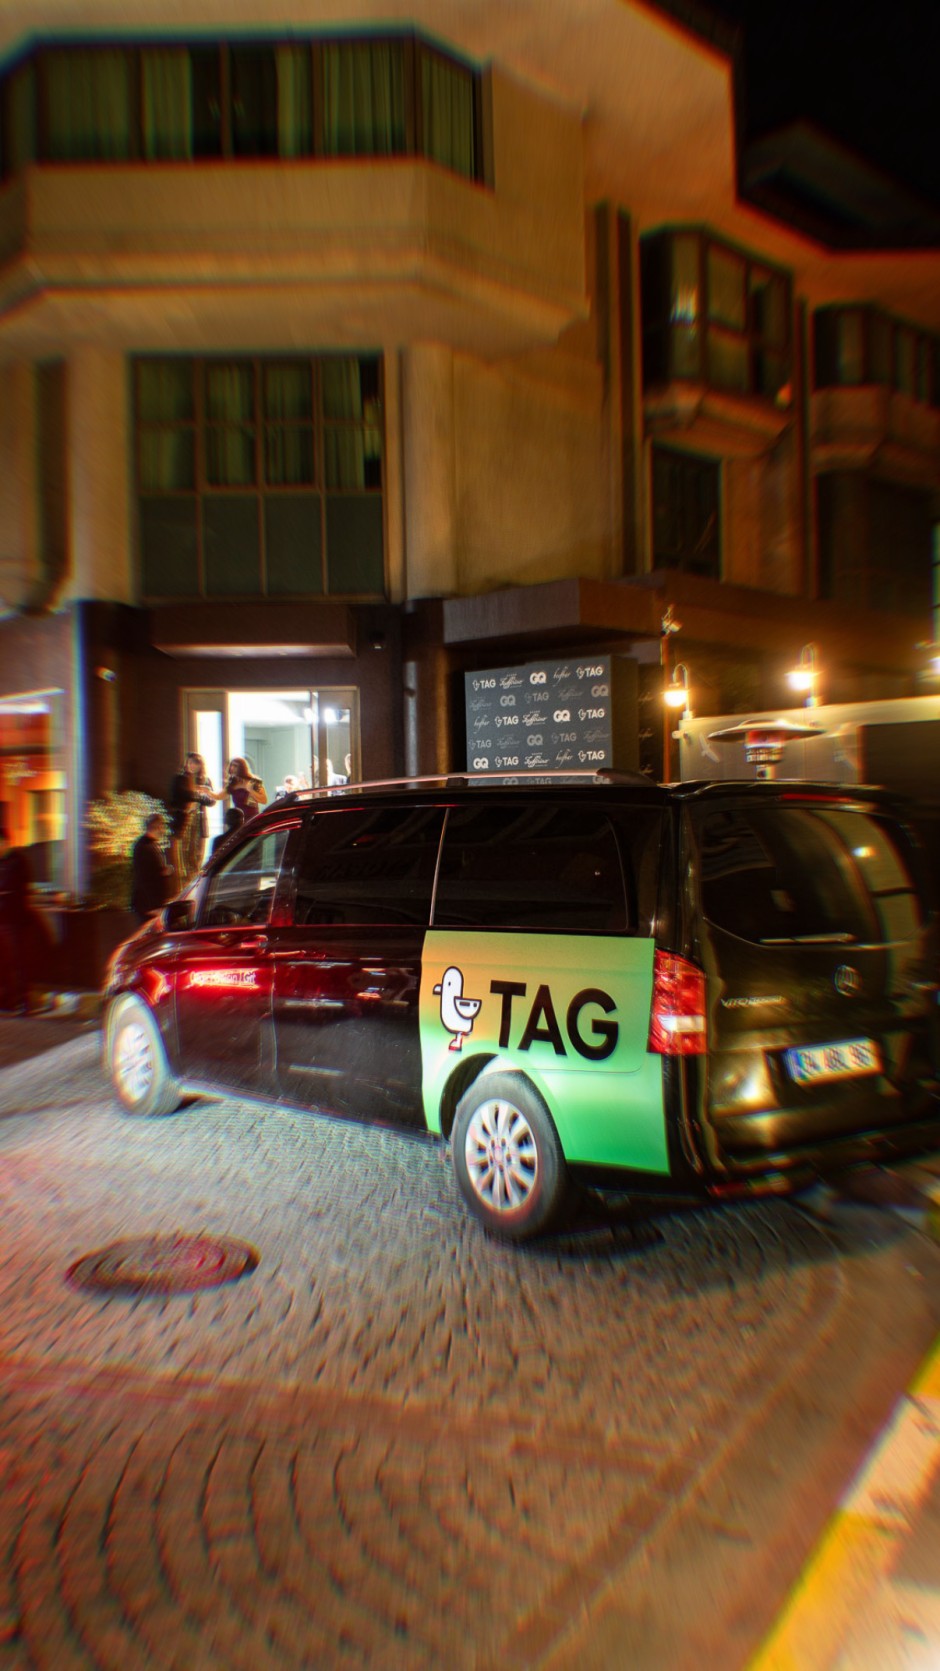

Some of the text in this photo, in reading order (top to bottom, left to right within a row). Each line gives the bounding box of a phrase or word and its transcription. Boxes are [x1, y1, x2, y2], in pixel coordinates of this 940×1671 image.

[480, 679, 496, 689] TAG
[529, 671, 547, 685] GQ
[584, 666, 604, 678] TAG
[499, 694, 516, 707] GQ
[532, 691, 549, 702] TAG
[591, 684, 609, 697] GQ
[502, 715, 519, 726] TAG
[553, 709, 571, 723] GQ
[586, 708, 605, 719] TAG
[476, 739, 492, 749] TAG
[526, 734, 544, 746] GQ
[560, 732, 577, 742] TAG
[473, 757, 489, 769] GQ
[502, 756, 519, 766] TAG
[586, 750, 605, 760] TAG
[490, 979, 619, 1061] TAG
